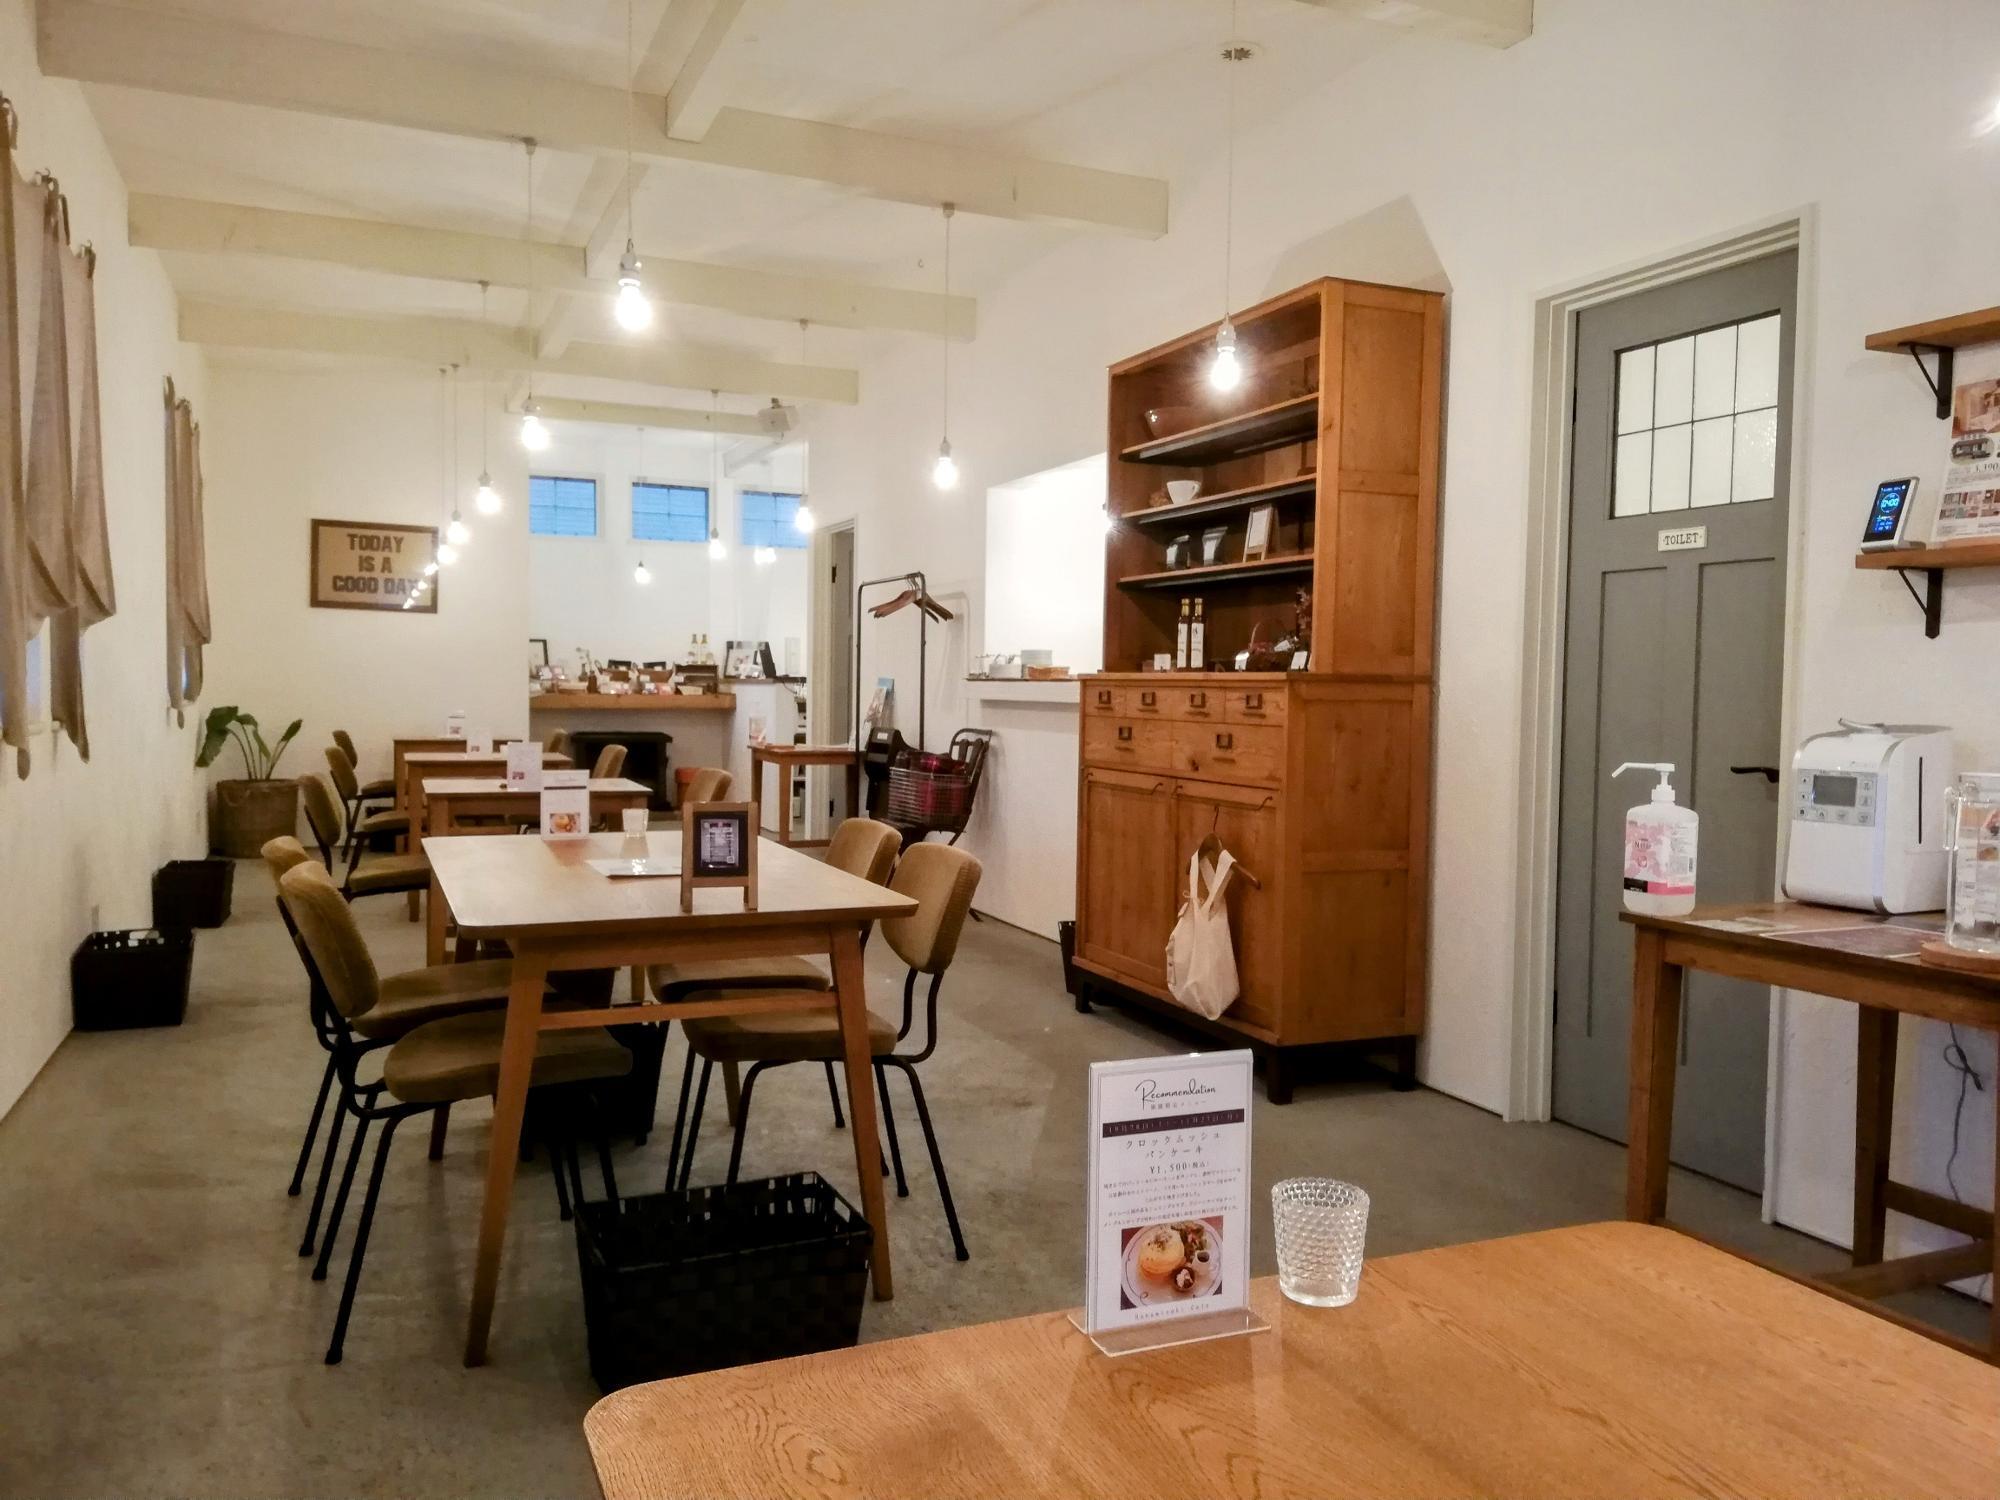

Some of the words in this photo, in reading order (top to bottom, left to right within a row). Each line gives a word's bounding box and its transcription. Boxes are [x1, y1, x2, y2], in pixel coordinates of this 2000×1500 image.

[347, 533, 404, 553] TODAY
[1664, 532, 1699, 546] TOILET
[358, 555, 375, 573] IS
[381, 556, 392, 573] A
[332, 575, 379, 594] GOOD
[1134, 1079, 1216, 1110] Recommendation
